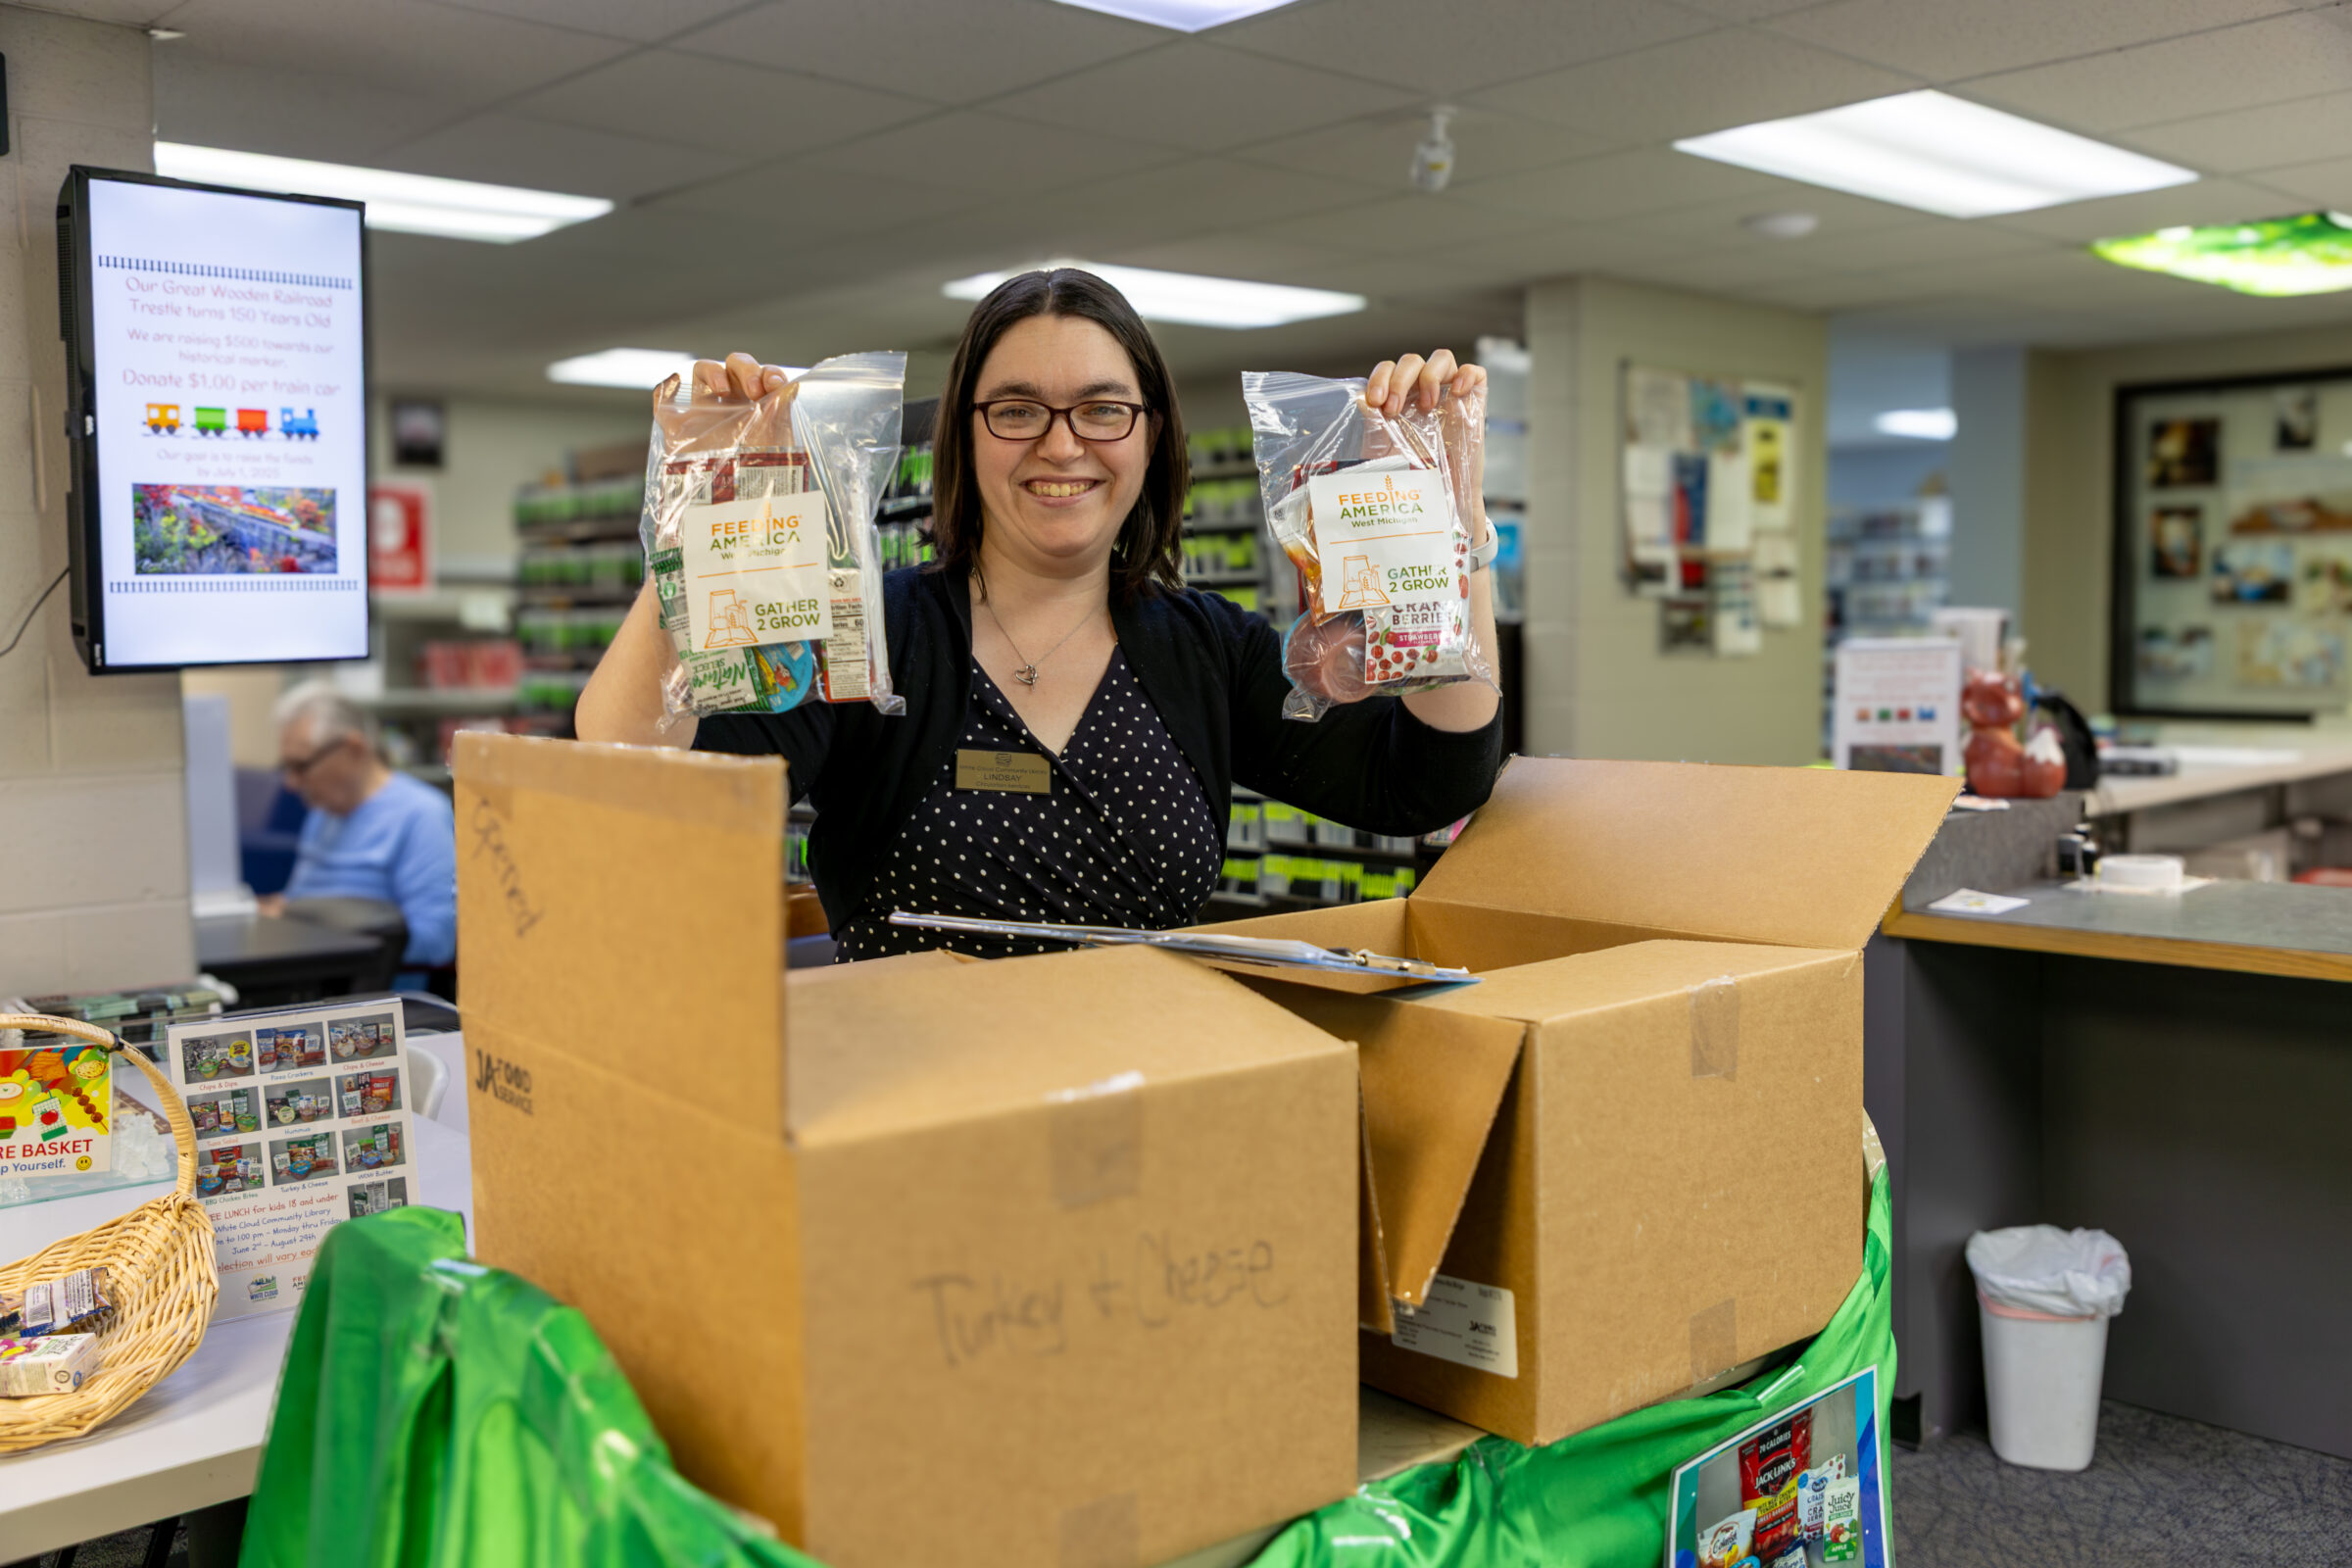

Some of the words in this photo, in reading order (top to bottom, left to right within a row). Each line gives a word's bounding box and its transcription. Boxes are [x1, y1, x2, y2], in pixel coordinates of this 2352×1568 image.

[125, 276, 158, 292] Our
[163, 280, 207, 297] Great
[211, 285, 270, 302] Wooden
[274, 290, 332, 308] Railroad
[130, 299, 181, 316] Trestle
[187, 306, 225, 320] turns
[230, 308, 256, 322] 150
[261, 311, 301, 326] Years
[305, 314, 331, 328] Old
[126, 328, 149, 341] We
[152, 332, 174, 343] are
[178, 334, 220, 348] raising
[225, 335, 259, 348] $500
[263, 340, 311, 353] towards
[315, 344, 334, 354] our
[179, 351, 235, 365] historical
[122, 369, 182, 387] Donate
[188, 373, 235, 390] $1.00
[241, 379, 270, 393] per
[272, 380, 310, 395] train
[315, 382, 341, 396] car
[158, 449, 180, 460] Our
[1339, 489, 1421, 506] FEEDING
[1341, 503, 1424, 519] AMERICA
[711, 515, 800, 536] FEEDING
[1351, 519, 1374, 528] West
[1390, 582, 1397, 593] 2
[1402, 577, 1449, 590] GROW
[755, 599, 818, 616] GATHER
[758, 618, 766, 631] 2
[770, 612, 820, 629] GROW
[984, 773, 1021, 782] LINDSAY
[343, 1062, 358, 1071] Chips
[367, 1059, 385, 1068] Cheese
[22, 1139, 94, 1157] BASKET
[12, 1158, 67, 1172] Yourself.
[280, 1184, 301, 1194] Turkey
[308, 1180, 328, 1189] Cheese
[210, 1213, 221, 1222] EE
[224, 1207, 250, 1220] LUNCH
[253, 1205, 266, 1214] for
[269, 1202, 286, 1211] kids
[288, 1199, 297, 1208] 18
[299, 1198, 314, 1206] and
[316, 1194, 339, 1203] under
[215, 1223, 236, 1234] White
[238, 1218, 260, 1229] Cloud
[262, 1212, 302, 1226] Community
[305, 1207, 331, 1218] Library
[253, 1231, 264, 1242] pm
[272, 1224, 300, 1237] Monday
[302, 1221, 318, 1230] thru
[319, 1217, 342, 1227] Friday
[231, 1247, 250, 1255] June
[270, 1238, 297, 1250] August
[299, 1232, 317, 1243] 29th
[217, 1259, 254, 1273] election
[257, 1254, 273, 1265] will
[275, 1250, 297, 1262] vary
[911, 1272, 1070, 1366] Turkey
[1759, 1444, 1766, 1452] 70
[1766, 1431, 1791, 1450] CALORIES
[1754, 1468, 1775, 1490] JACK
[1775, 1457, 1796, 1479] LINK'S
[1807, 1492, 1825, 1503] CRAIS
[1828, 1492, 1855, 1506] Juicy
[1807, 1506, 1824, 1515] CRA
[1830, 1503, 1852, 1513] Juice
